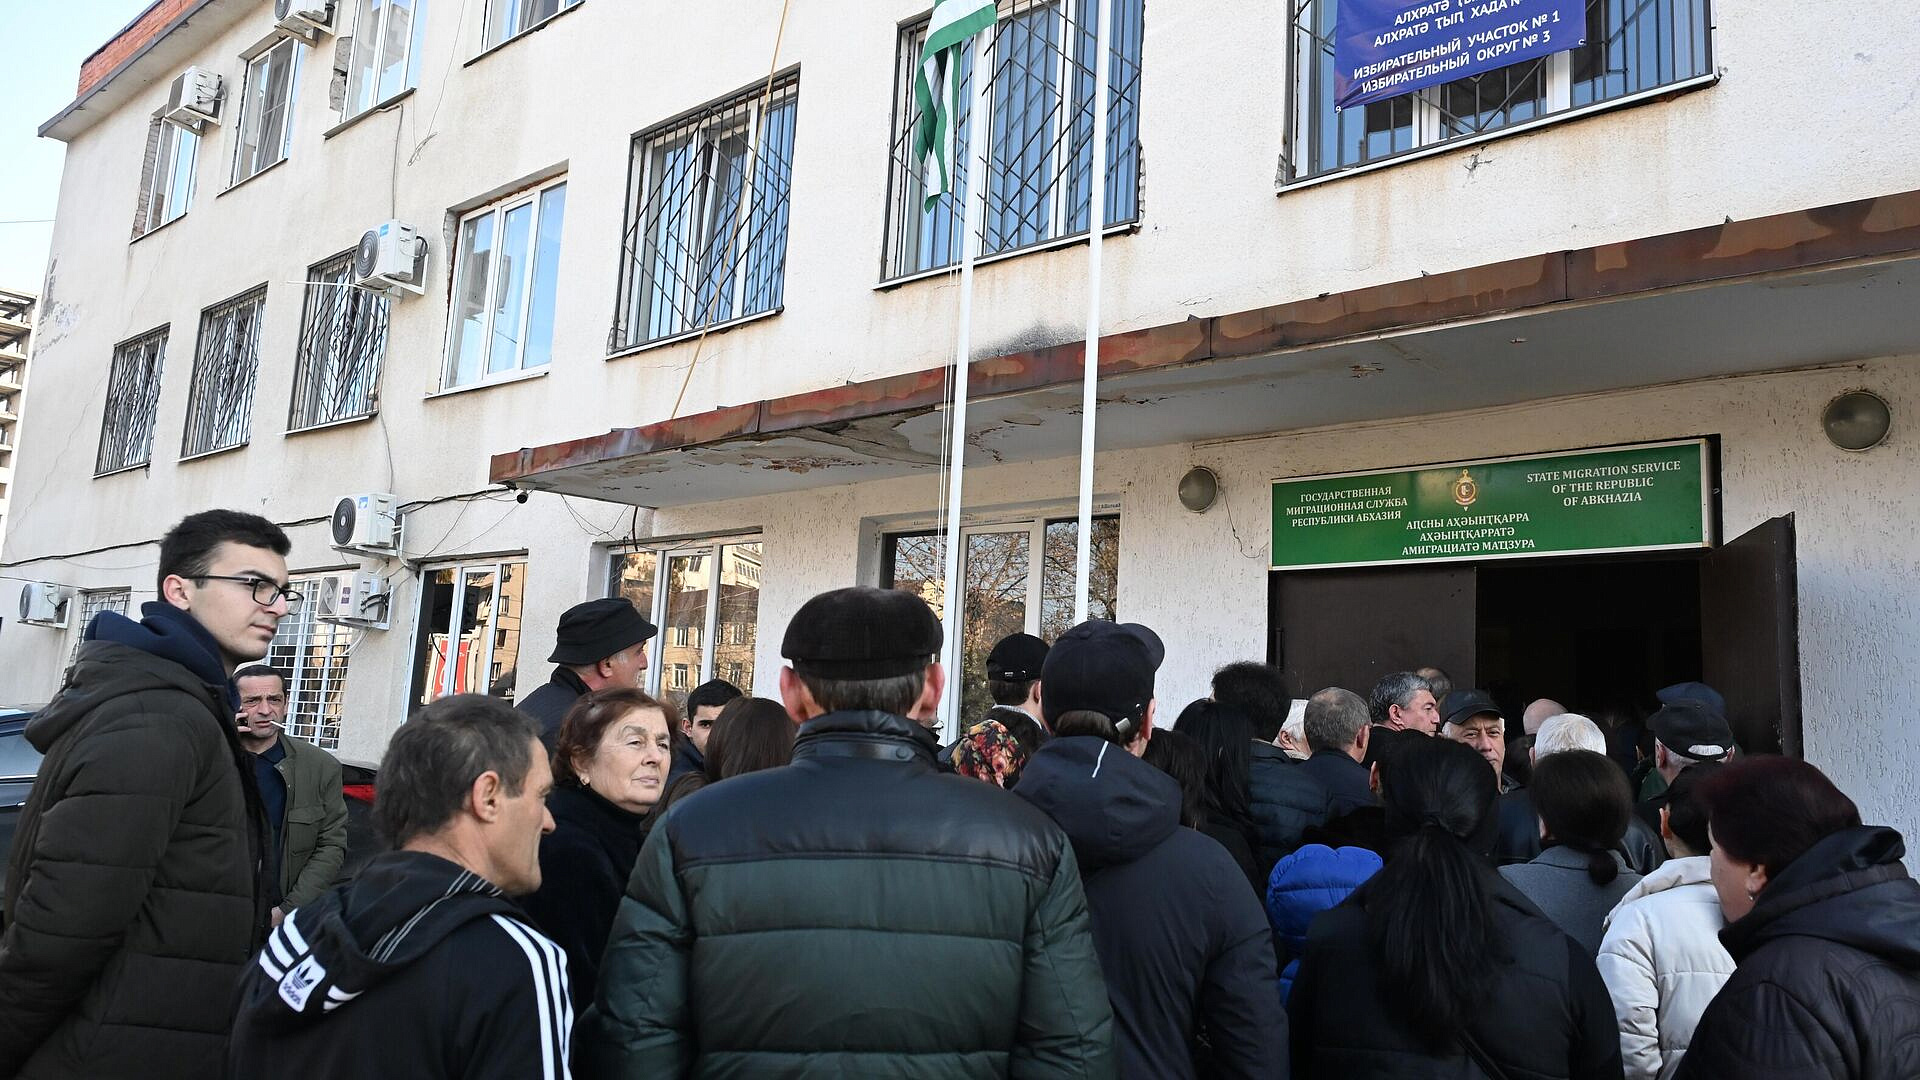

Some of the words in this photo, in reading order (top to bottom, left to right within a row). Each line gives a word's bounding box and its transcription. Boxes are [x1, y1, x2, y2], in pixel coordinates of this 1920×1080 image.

[1375, 22, 1429, 47] АЛХРАТӘ
[1470, 0, 1508, 19] ХАДА
[1353, 37, 1461, 80] ИЗБИРАТЕЛЬНЫЙ
[1467, 19, 1529, 48] УЧАСТОК
[1532, 13, 1548, 29] №
[1552, 10, 1561, 23] 1
[1361, 51, 1470, 94] ИЗБИРАТЕЛЬНЫЙ
[1476, 38, 1521, 61] ОКРУГ
[1522, 33, 1539, 49] №
[1542, 30, 1551, 43] 3
[1526, 471, 1560, 483] STATE
[1562, 465, 1629, 480] MIGRATION
[1631, 460, 1681, 474] SERVICE
[1300, 486, 1392, 503] ГОСУДАРСТВЕННАЯ
[1552, 484, 1567, 494] OF
[1569, 482, 1593, 492] THE
[1595, 476, 1654, 490] REPUBLIC
[1286, 501, 1364, 516] МИГРАЦИОННАЯ
[1365, 497, 1408, 509] СЛУЖБА
[1563, 497, 1579, 507] OF
[1580, 492, 1642, 506] ABKHAZIA
[1292, 515, 1354, 527] РЕСПУБЛИКИ
[1356, 510, 1401, 522] АБХАЗИЯ
